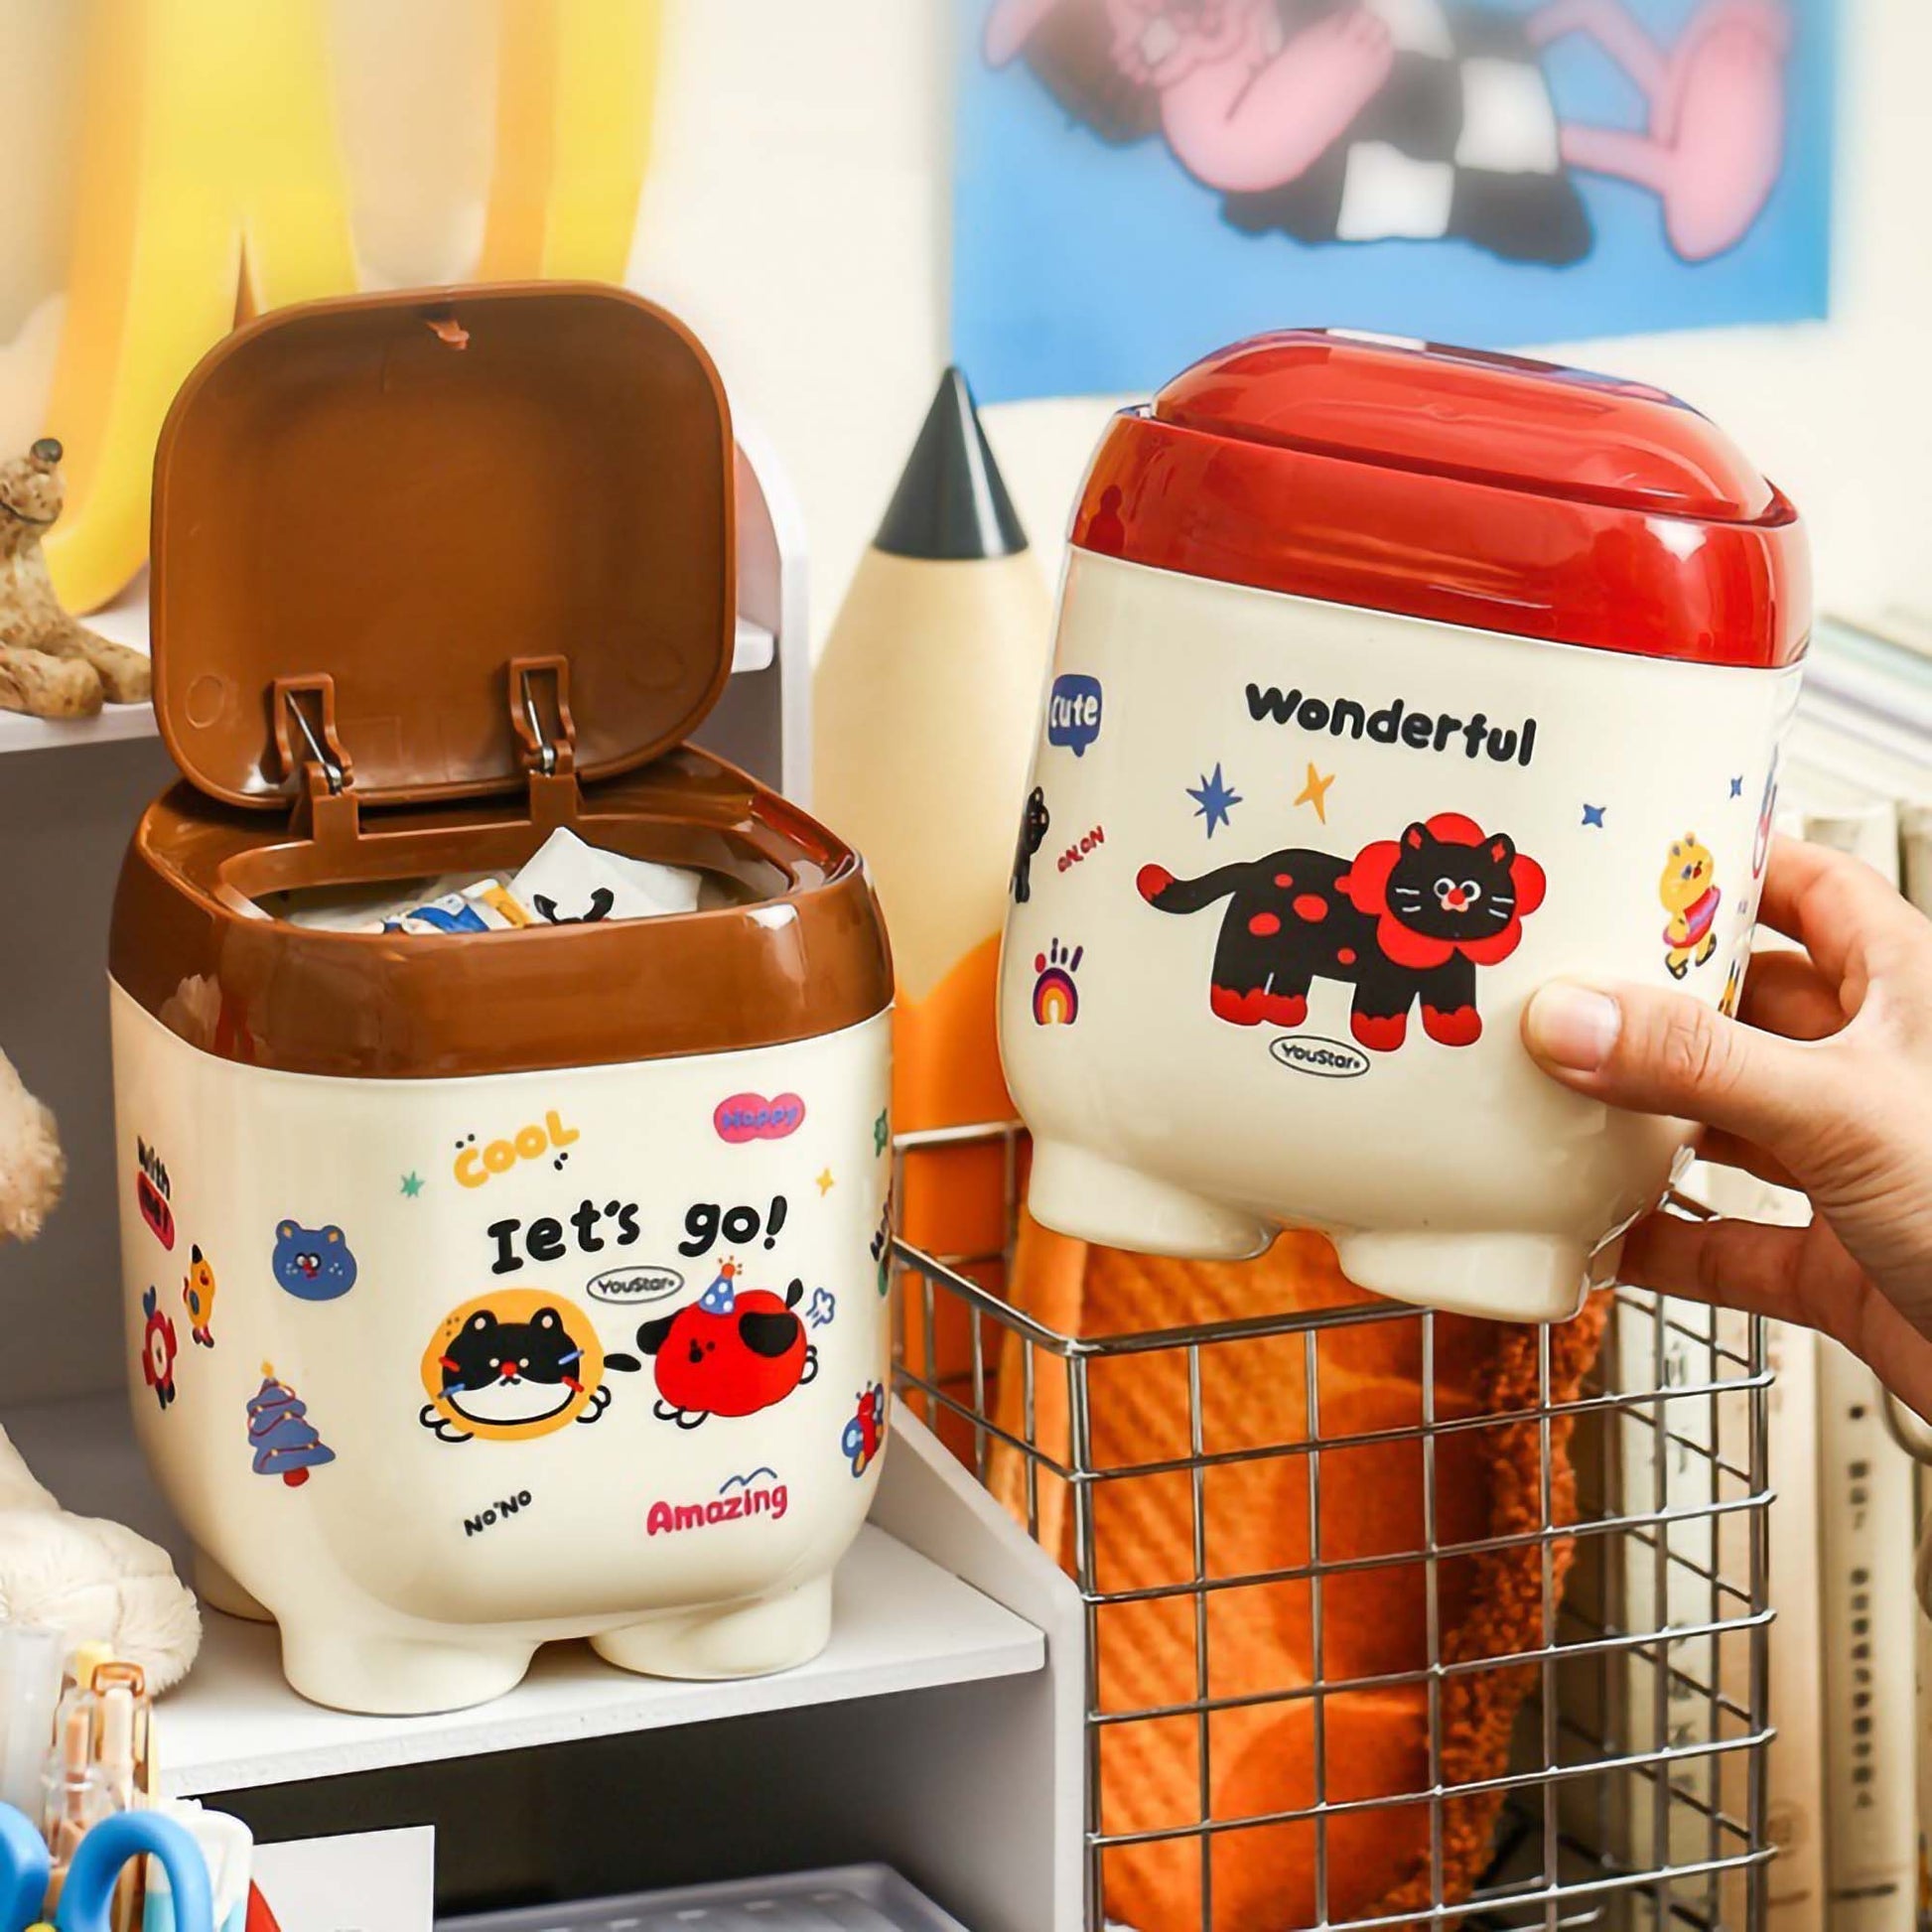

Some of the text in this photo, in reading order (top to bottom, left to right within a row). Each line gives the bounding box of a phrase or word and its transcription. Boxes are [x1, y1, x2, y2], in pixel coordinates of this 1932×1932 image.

[454, 1110, 580, 1188] COOL
[678, 1195, 788, 1258] go!
[645, 1484, 788, 1536] Amazing
